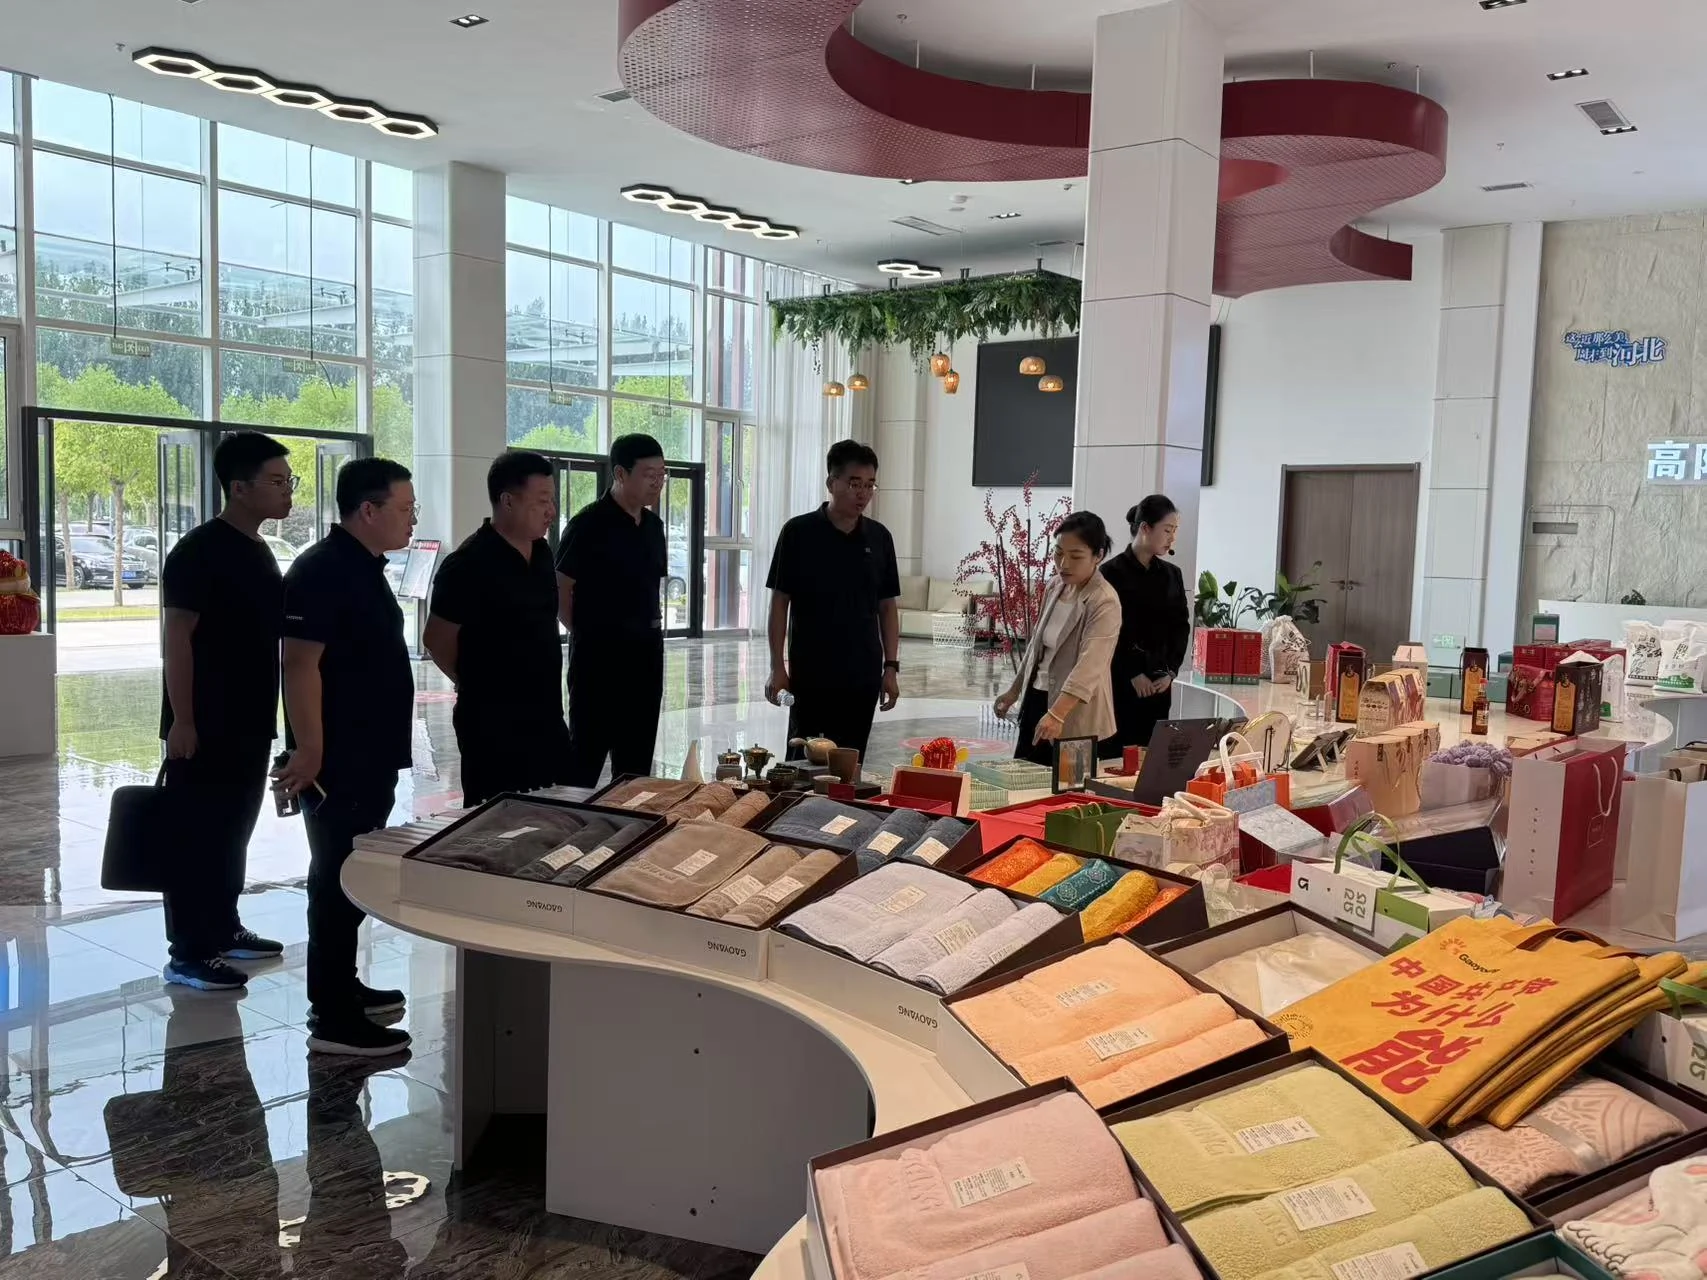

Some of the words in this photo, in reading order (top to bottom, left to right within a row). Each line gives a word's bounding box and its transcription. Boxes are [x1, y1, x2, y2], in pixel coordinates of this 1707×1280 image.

[526, 900, 563, 912] GAOYANG
[707, 940, 747, 957] GAOYANG
[1390, 957, 1559, 1001] 中国共产党
[898, 1005, 938, 1029] GAOYANG
[1371, 991, 1515, 1028] 为什么
[1339, 1028, 1484, 1095] 能
